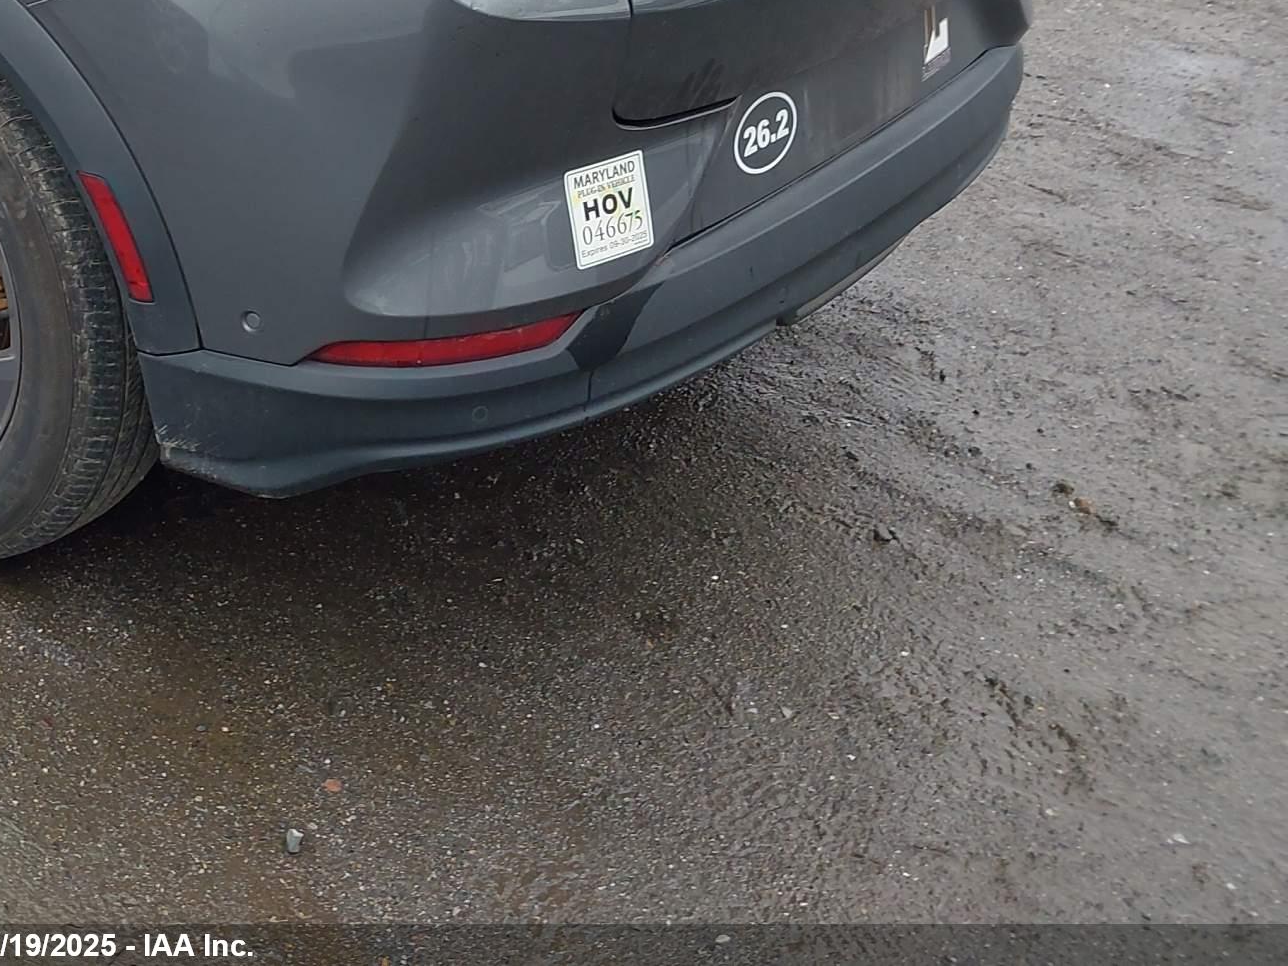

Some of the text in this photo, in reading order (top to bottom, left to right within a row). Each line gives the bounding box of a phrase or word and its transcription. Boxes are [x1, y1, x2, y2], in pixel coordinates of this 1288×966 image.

[743, 108, 790, 158] 26.2
[573, 160, 635, 190] MARYLAND
[606, 174, 635, 189] VEHICLE
[583, 187, 633, 221] HOV
[582, 209, 643, 246] 046675
